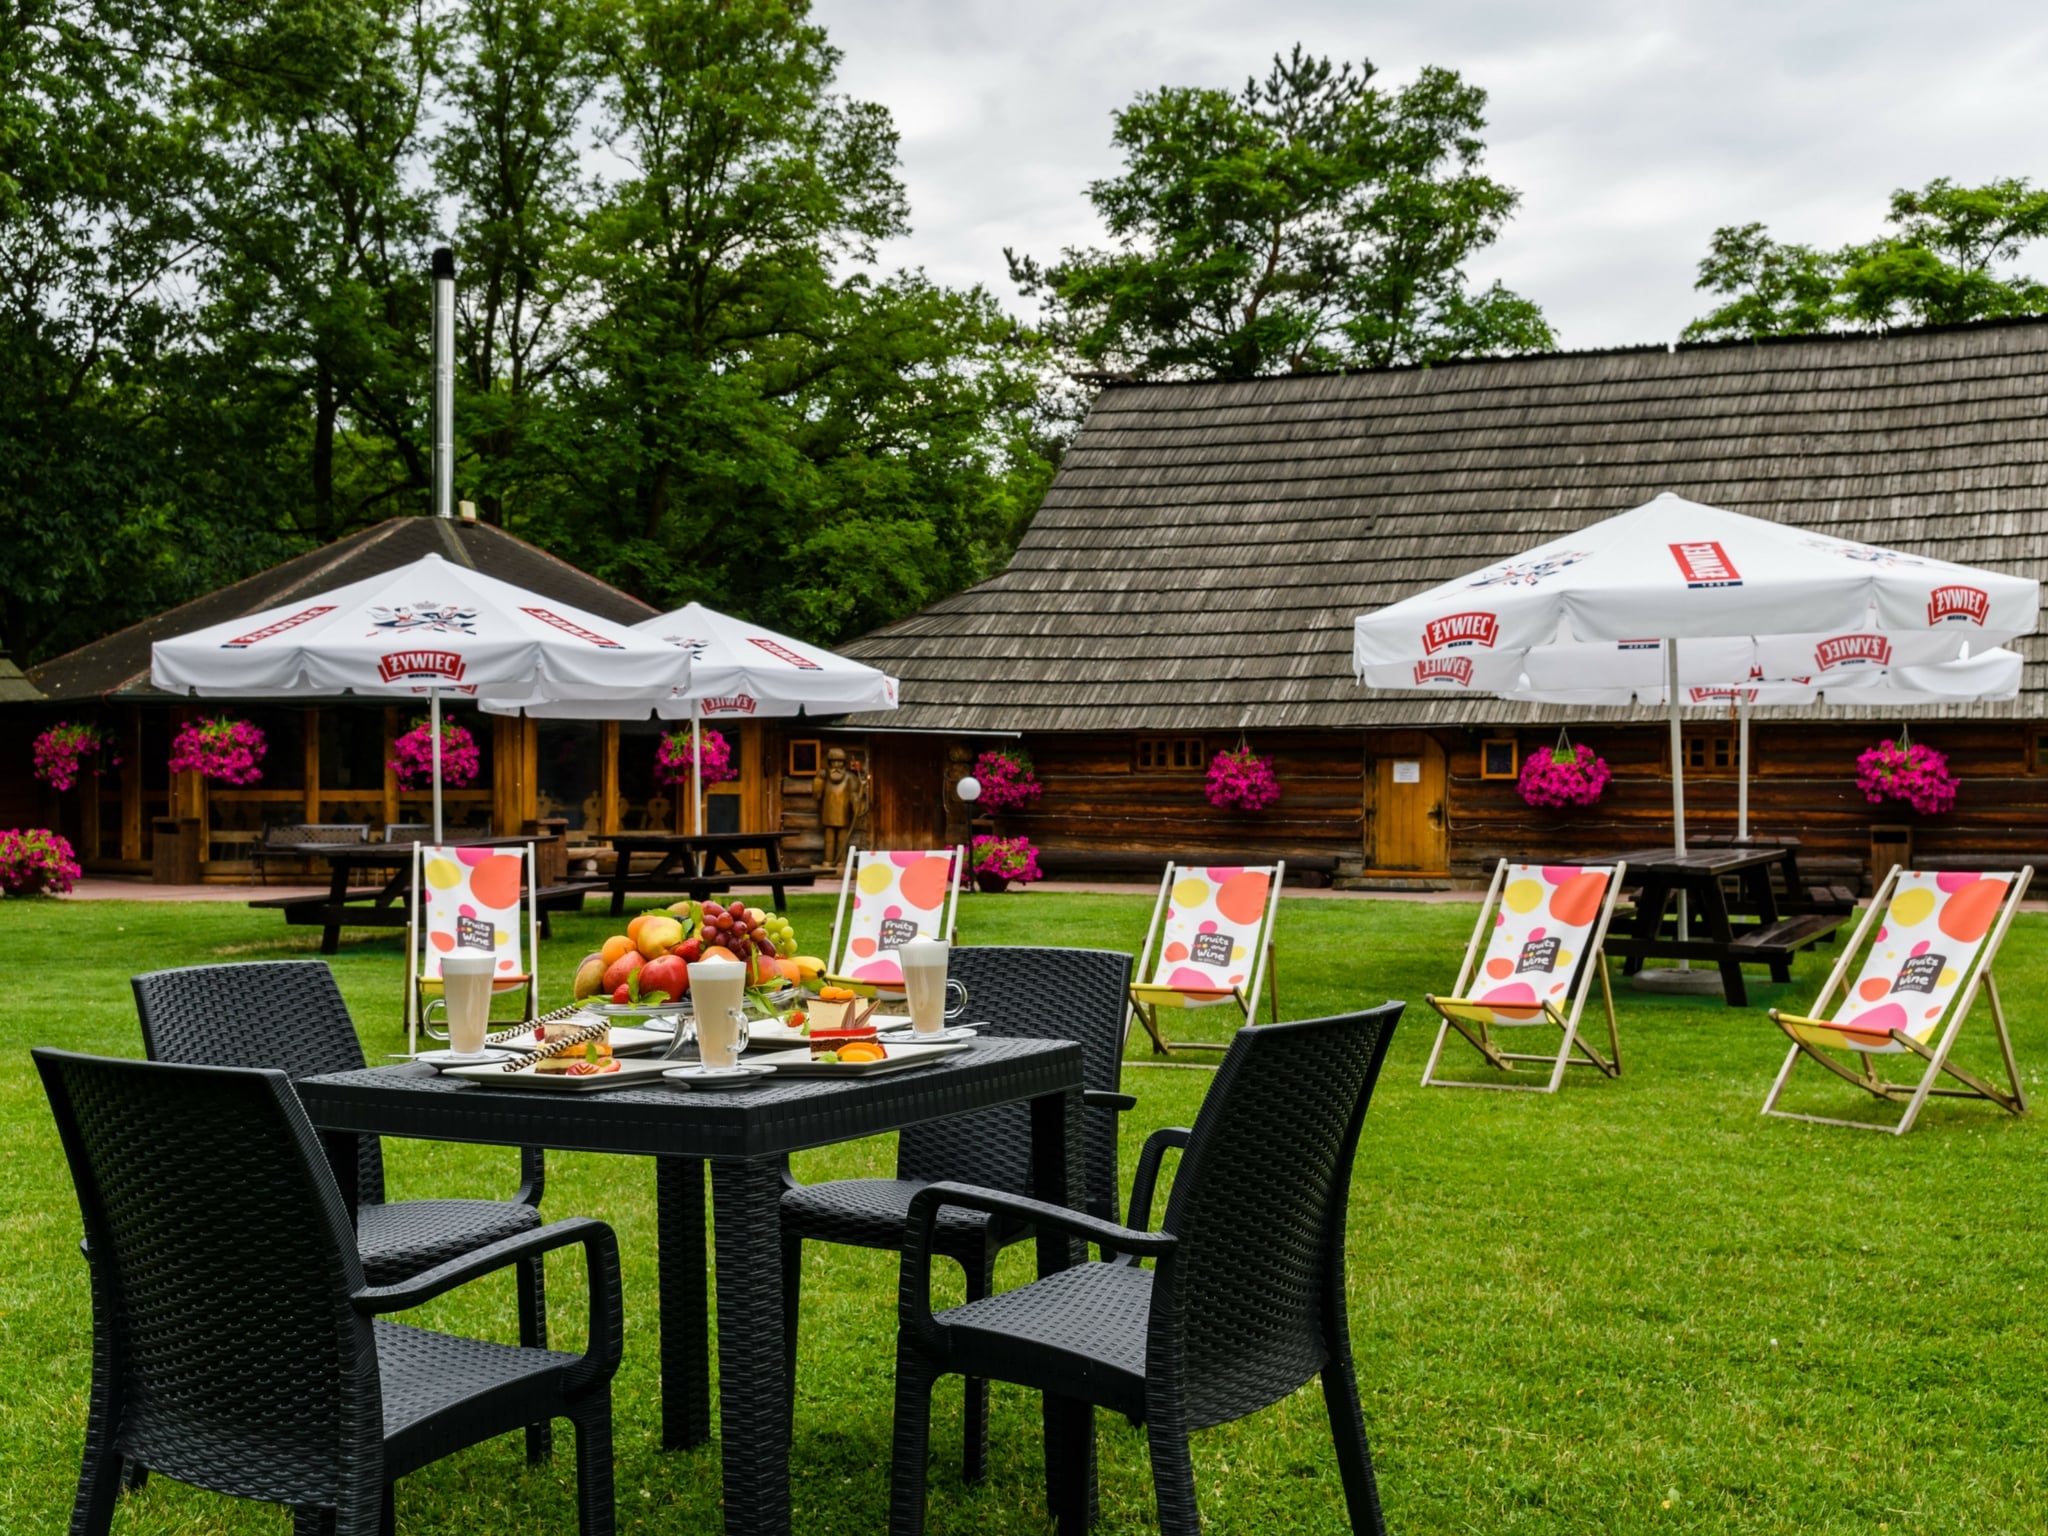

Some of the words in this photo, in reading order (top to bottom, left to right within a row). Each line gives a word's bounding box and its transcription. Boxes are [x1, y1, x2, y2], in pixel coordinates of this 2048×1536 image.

[1936, 588, 1984, 614] ŻYWIEC
[1432, 615, 1491, 643] ŻYWIEC
[388, 652, 455, 673] ŻYWIEC
[886, 922, 913, 931] Fruits
[1200, 935, 1229, 946] Fruits
[1198, 950, 1225, 961] Wine
